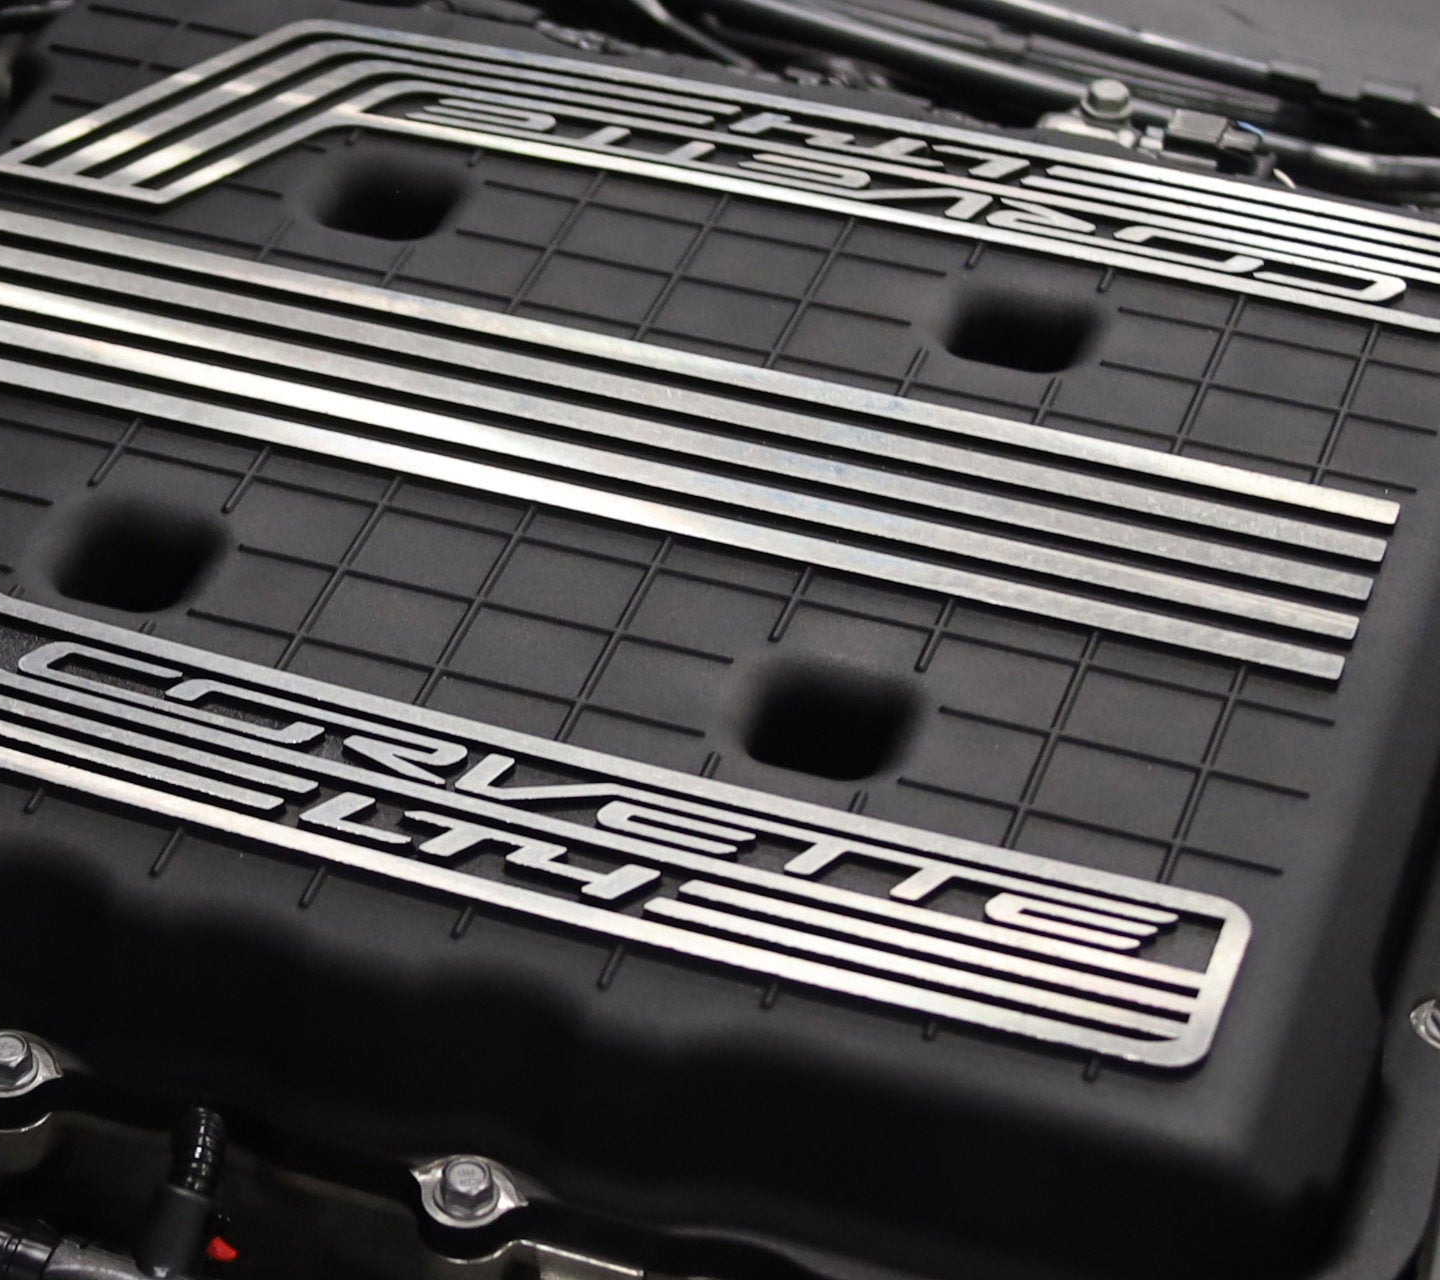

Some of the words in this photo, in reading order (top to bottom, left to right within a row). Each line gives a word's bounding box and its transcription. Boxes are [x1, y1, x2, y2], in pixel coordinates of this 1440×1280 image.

[404, 96, 1409, 304] CORVETTE
[728, 110, 1032, 182] LT4
[15, 639, 1182, 951] CORVETTE
[297, 794, 662, 901] LT4
